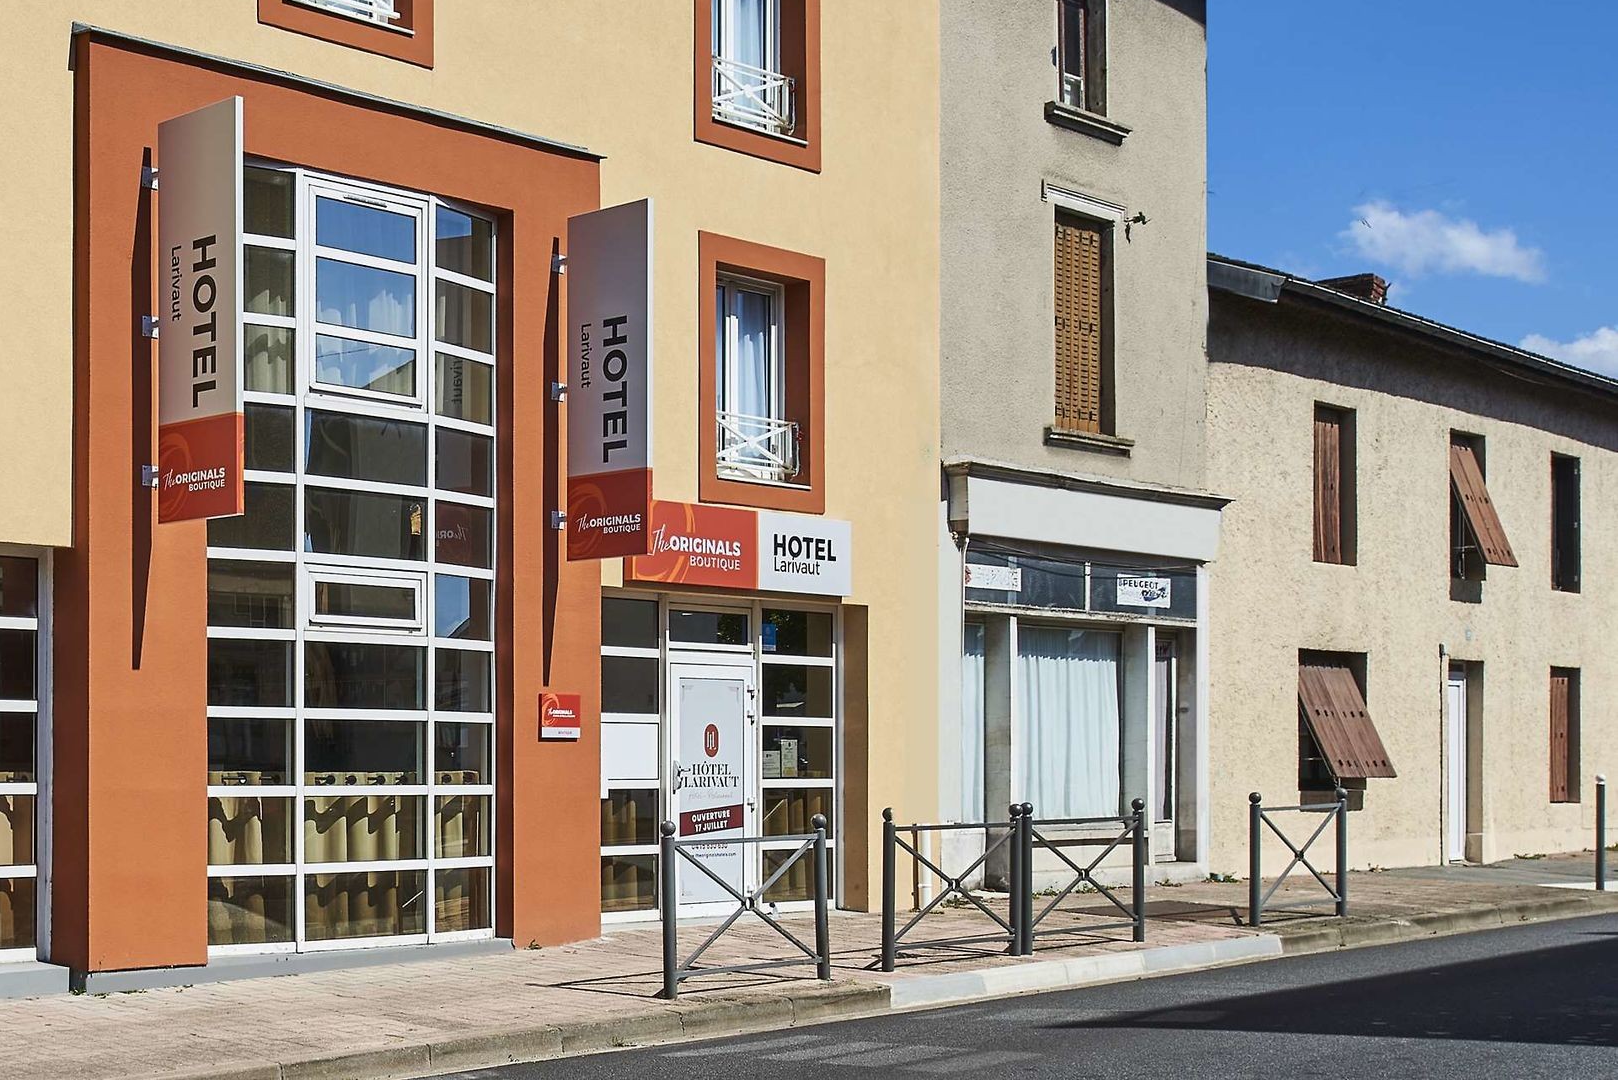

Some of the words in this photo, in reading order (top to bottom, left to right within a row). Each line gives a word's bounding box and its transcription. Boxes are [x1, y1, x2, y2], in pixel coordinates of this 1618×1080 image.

[171, 245, 183, 322] Larivaut
[193, 234, 217, 408] HOTEL
[581, 323, 593, 389] Larivaut
[602, 315, 628, 463] HOTEL
[162, 468, 177, 491] The
[175, 467, 226, 485] ORIGINALS
[188, 478, 226, 492] BOUTIQUE
[576, 513, 590, 533] The
[589, 513, 641, 528] ORIGINALS
[603, 523, 641, 534] BOUTIQUE
[647, 523, 671, 556] The
[669, 535, 741, 557] ORIGINALS
[773, 533, 837, 562] HOTEL
[689, 555, 741, 571] BOUTIQUE
[773, 556, 821, 576] Larivaut
[1123, 579, 1159, 590] PEUGEOT
[684, 775, 740, 788] LARIVAUT
[691, 809, 731, 823] OUVERTURE
[694, 823, 702, 832] 17
[702, 820, 728, 832] JUILLET
